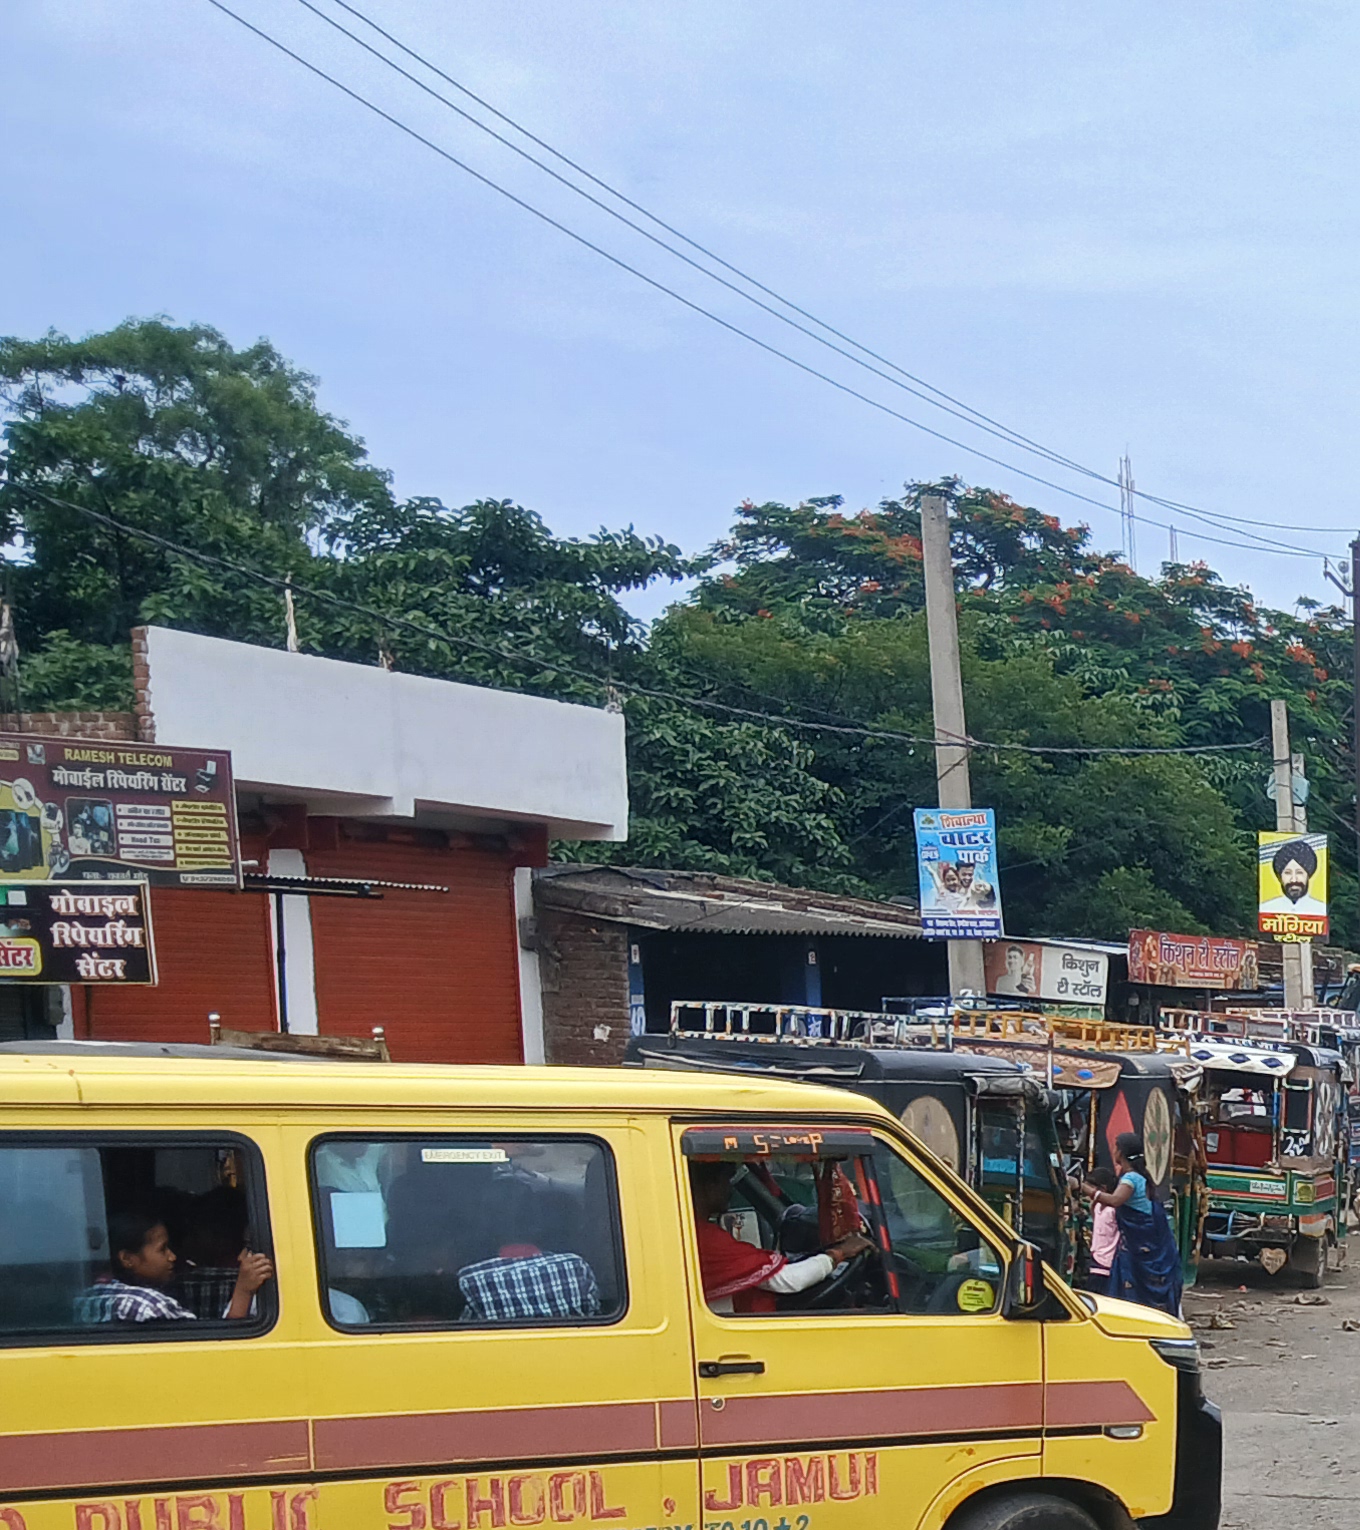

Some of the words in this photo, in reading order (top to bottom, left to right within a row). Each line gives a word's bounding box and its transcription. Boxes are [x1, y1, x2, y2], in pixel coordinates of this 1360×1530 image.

[64, 748, 115, 764] RAMESH
[117, 752, 173, 768] TELECOM
[49, 889, 140, 920] मोबाइल
[50, 920, 145, 948] रिपेयरिंग
[75, 952, 127, 980] सेंटर
[482, 1151, 502, 1160] EXIT
[704, 1451, 880, 1511] JAMUI
